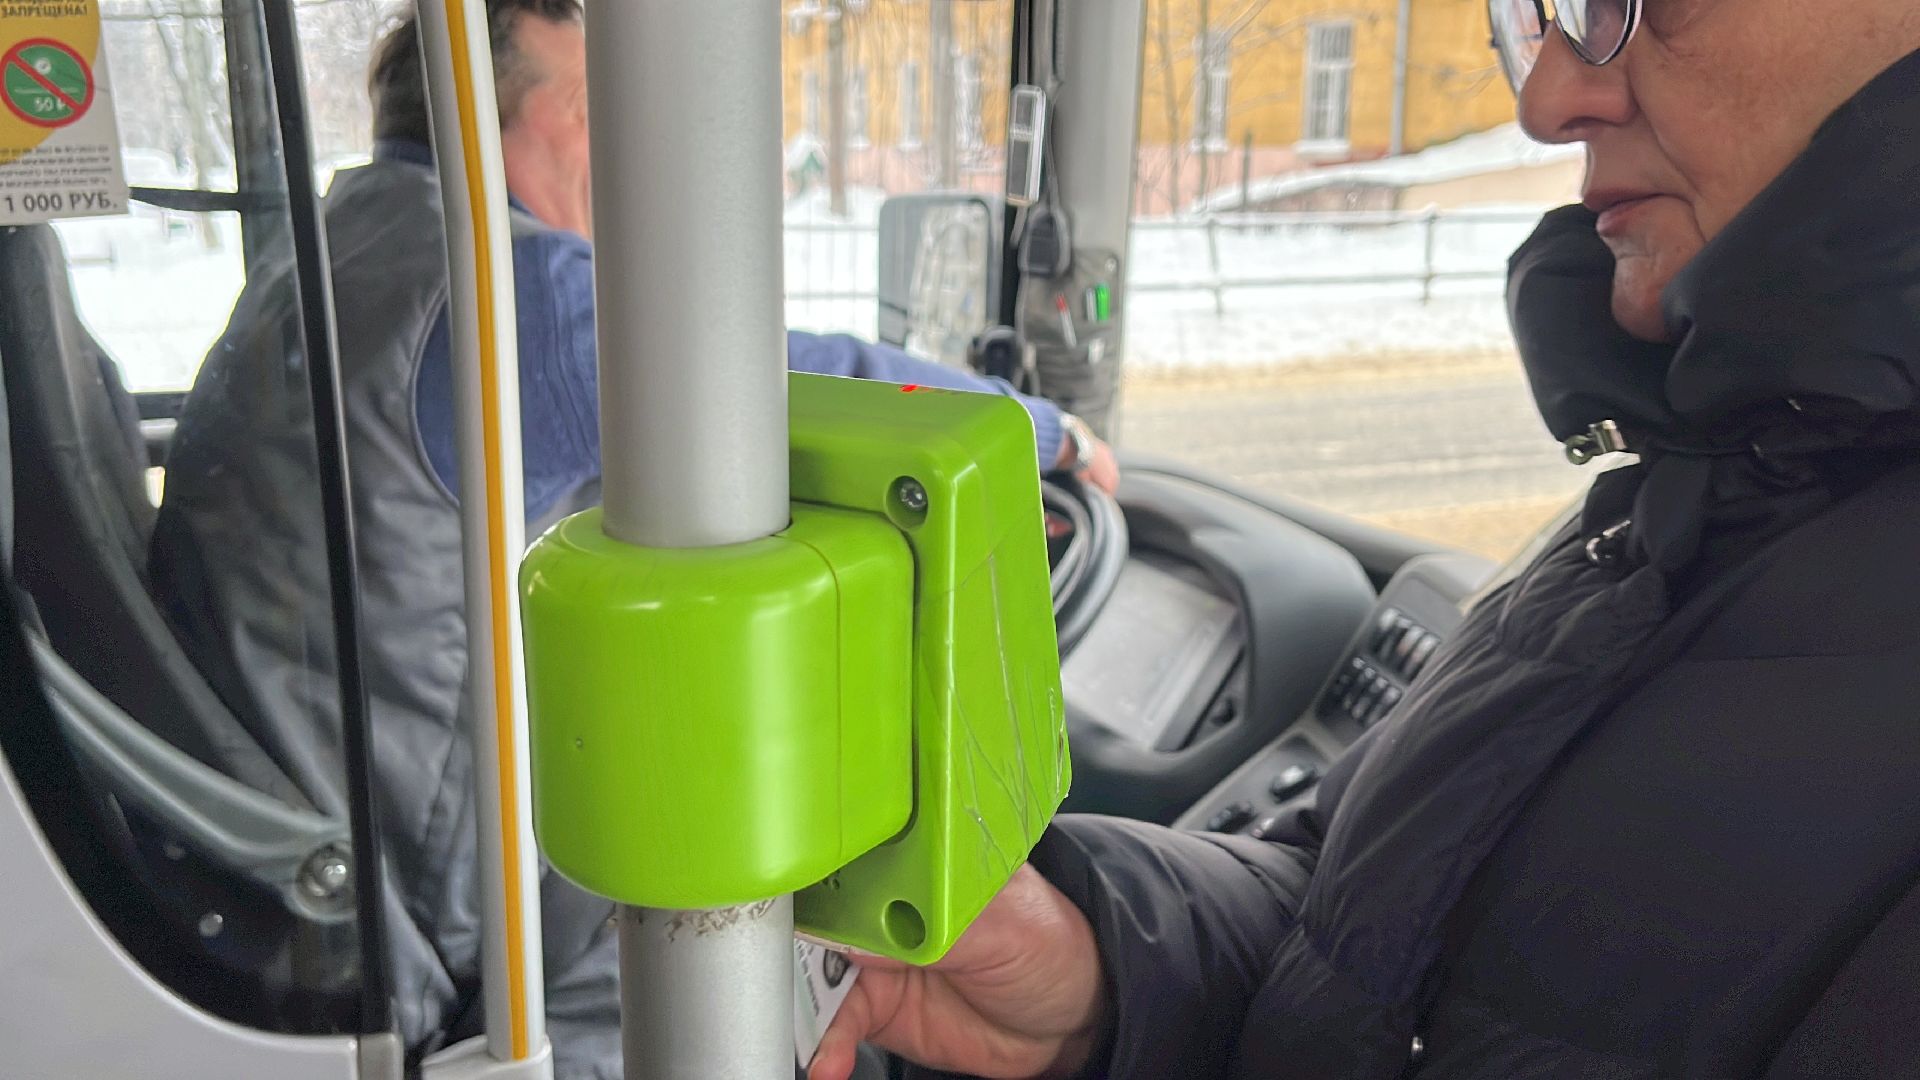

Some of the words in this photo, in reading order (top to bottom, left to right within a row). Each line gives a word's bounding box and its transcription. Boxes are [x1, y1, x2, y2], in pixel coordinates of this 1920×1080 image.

[1, 4, 88, 18] ЗАПРЕЩЕНА!
[5, 195, 14, 213] 1
[24, 193, 62, 212] 000
[69, 190, 118, 210] РУБ.
